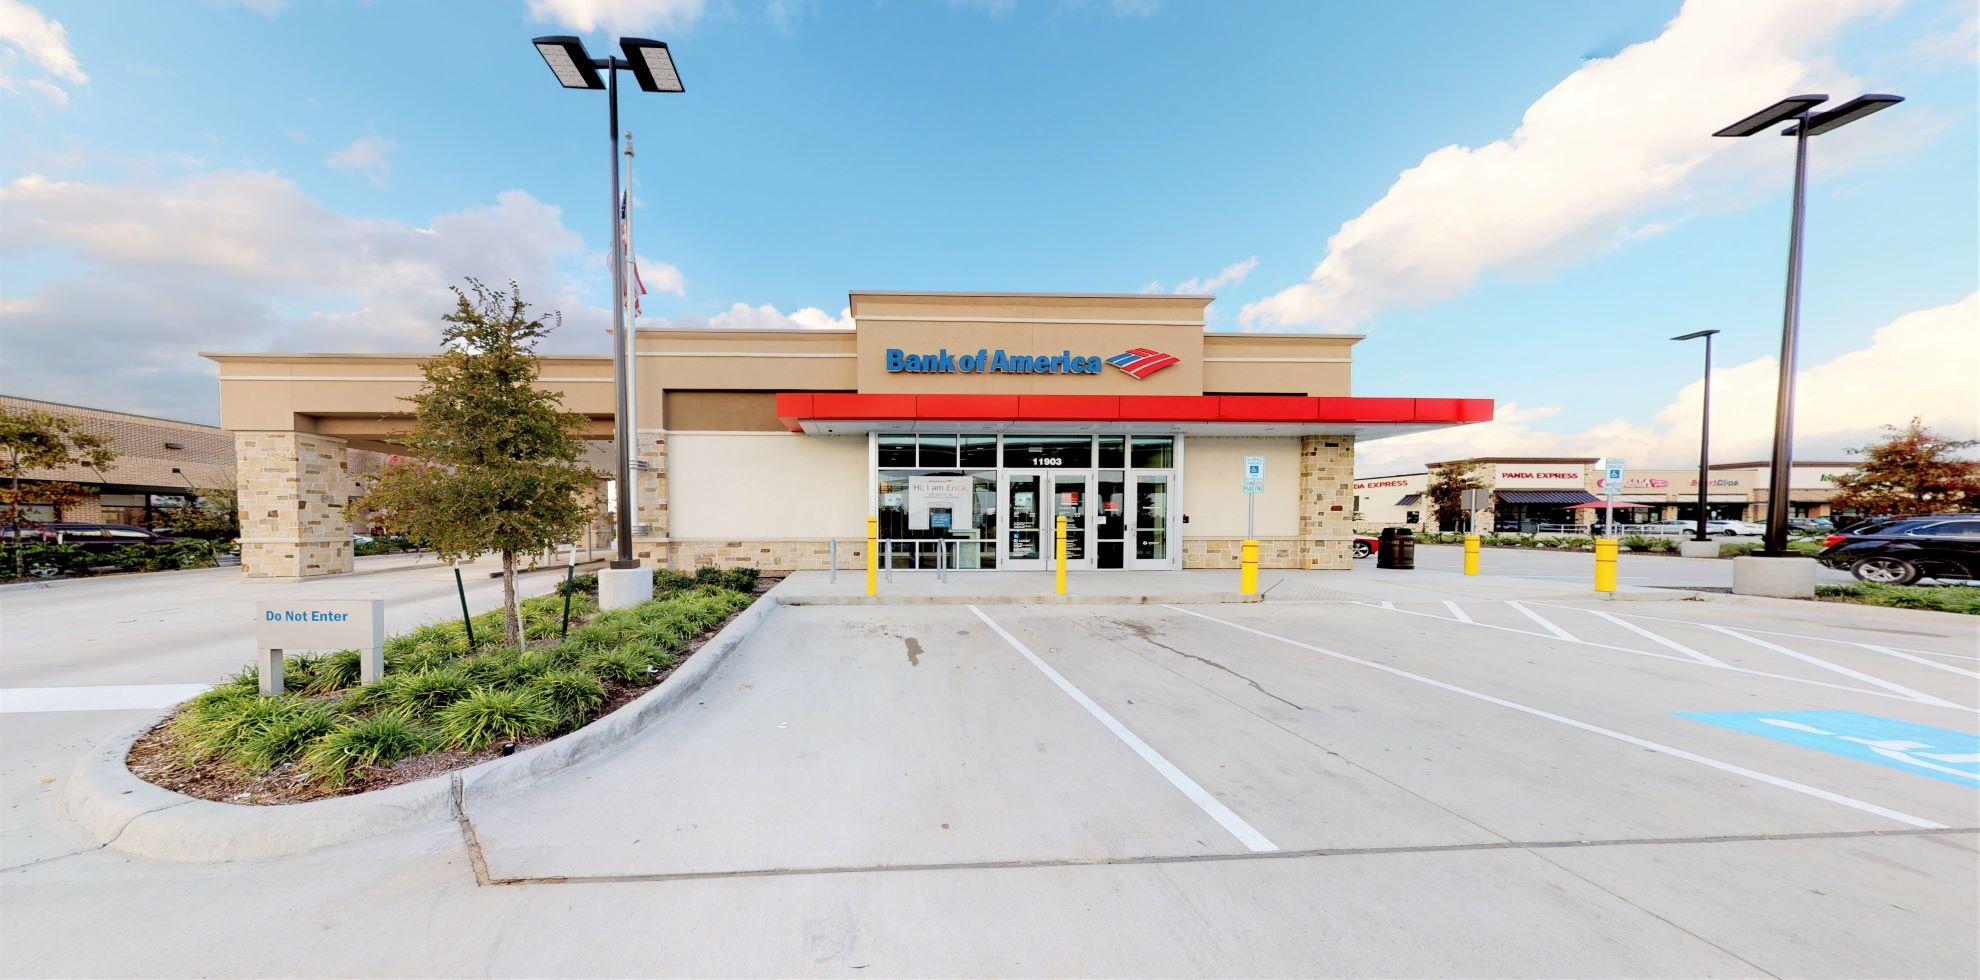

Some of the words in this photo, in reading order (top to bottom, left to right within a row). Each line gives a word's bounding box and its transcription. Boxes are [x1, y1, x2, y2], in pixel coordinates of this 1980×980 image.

[886, 348, 955, 373] Bank
[957, 349, 988, 373] of
[988, 349, 1102, 374] America
[1033, 457, 1062, 466] 11903
[1367, 480, 1408, 489] EXPRESS
[266, 610, 282, 621] Do
[285, 610, 308, 621] Not
[311, 610, 349, 621] Enter
